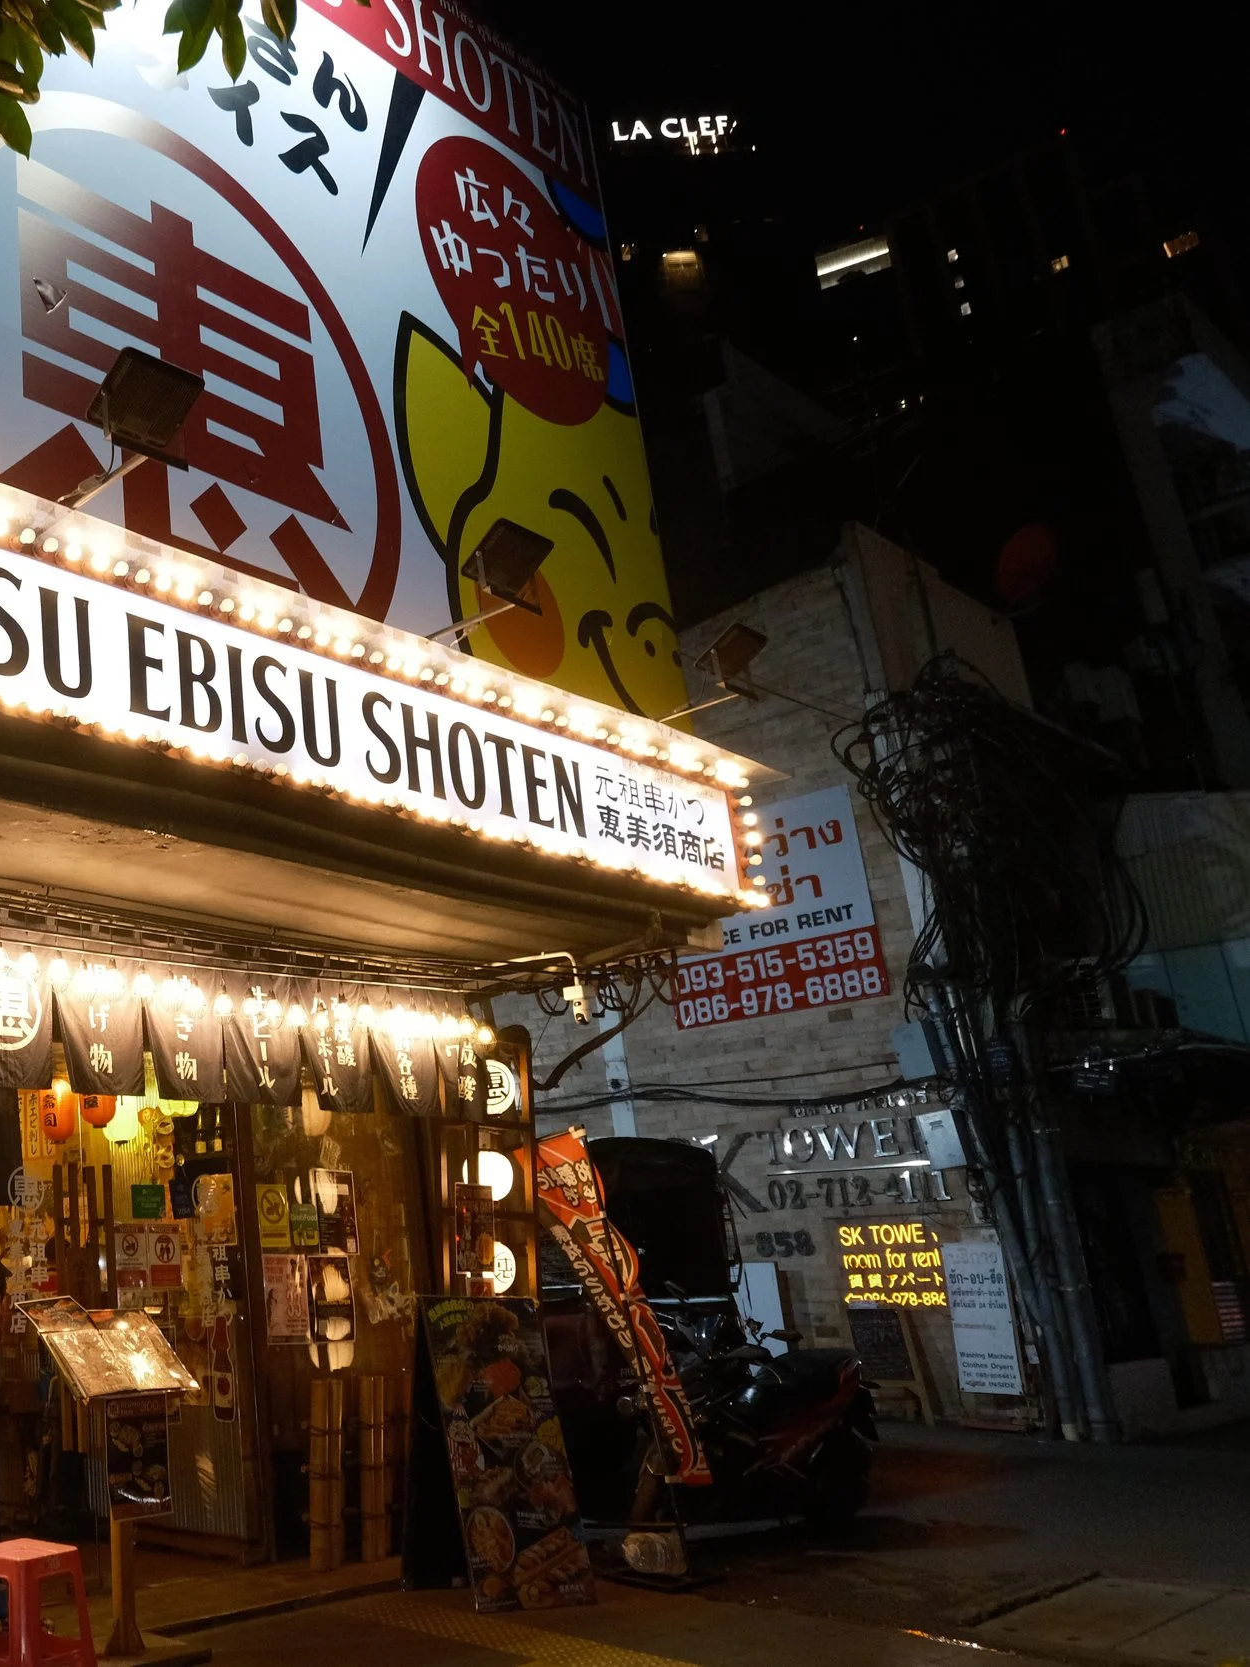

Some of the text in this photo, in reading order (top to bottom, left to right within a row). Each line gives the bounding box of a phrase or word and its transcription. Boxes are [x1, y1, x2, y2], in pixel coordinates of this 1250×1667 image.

[612, 120, 652, 141] LA
[453, 166, 535, 240] 広々
[430, 219, 588, 312] ゆったり
[471, 301, 605, 382] 全140席
[125, 610, 342, 770] EBISU
[360, 690, 588, 840] SHOTEN
[594, 765, 706, 827] 元祖串かつ
[749, 919, 790, 940] FOR
[796, 903, 854, 930] RENT
[678, 966, 883, 1029] 086-978-6888
[838, 1223, 938, 1247] SK TOWE
[842, 1253, 882, 1269] room
[885, 1247, 907, 1269] for
